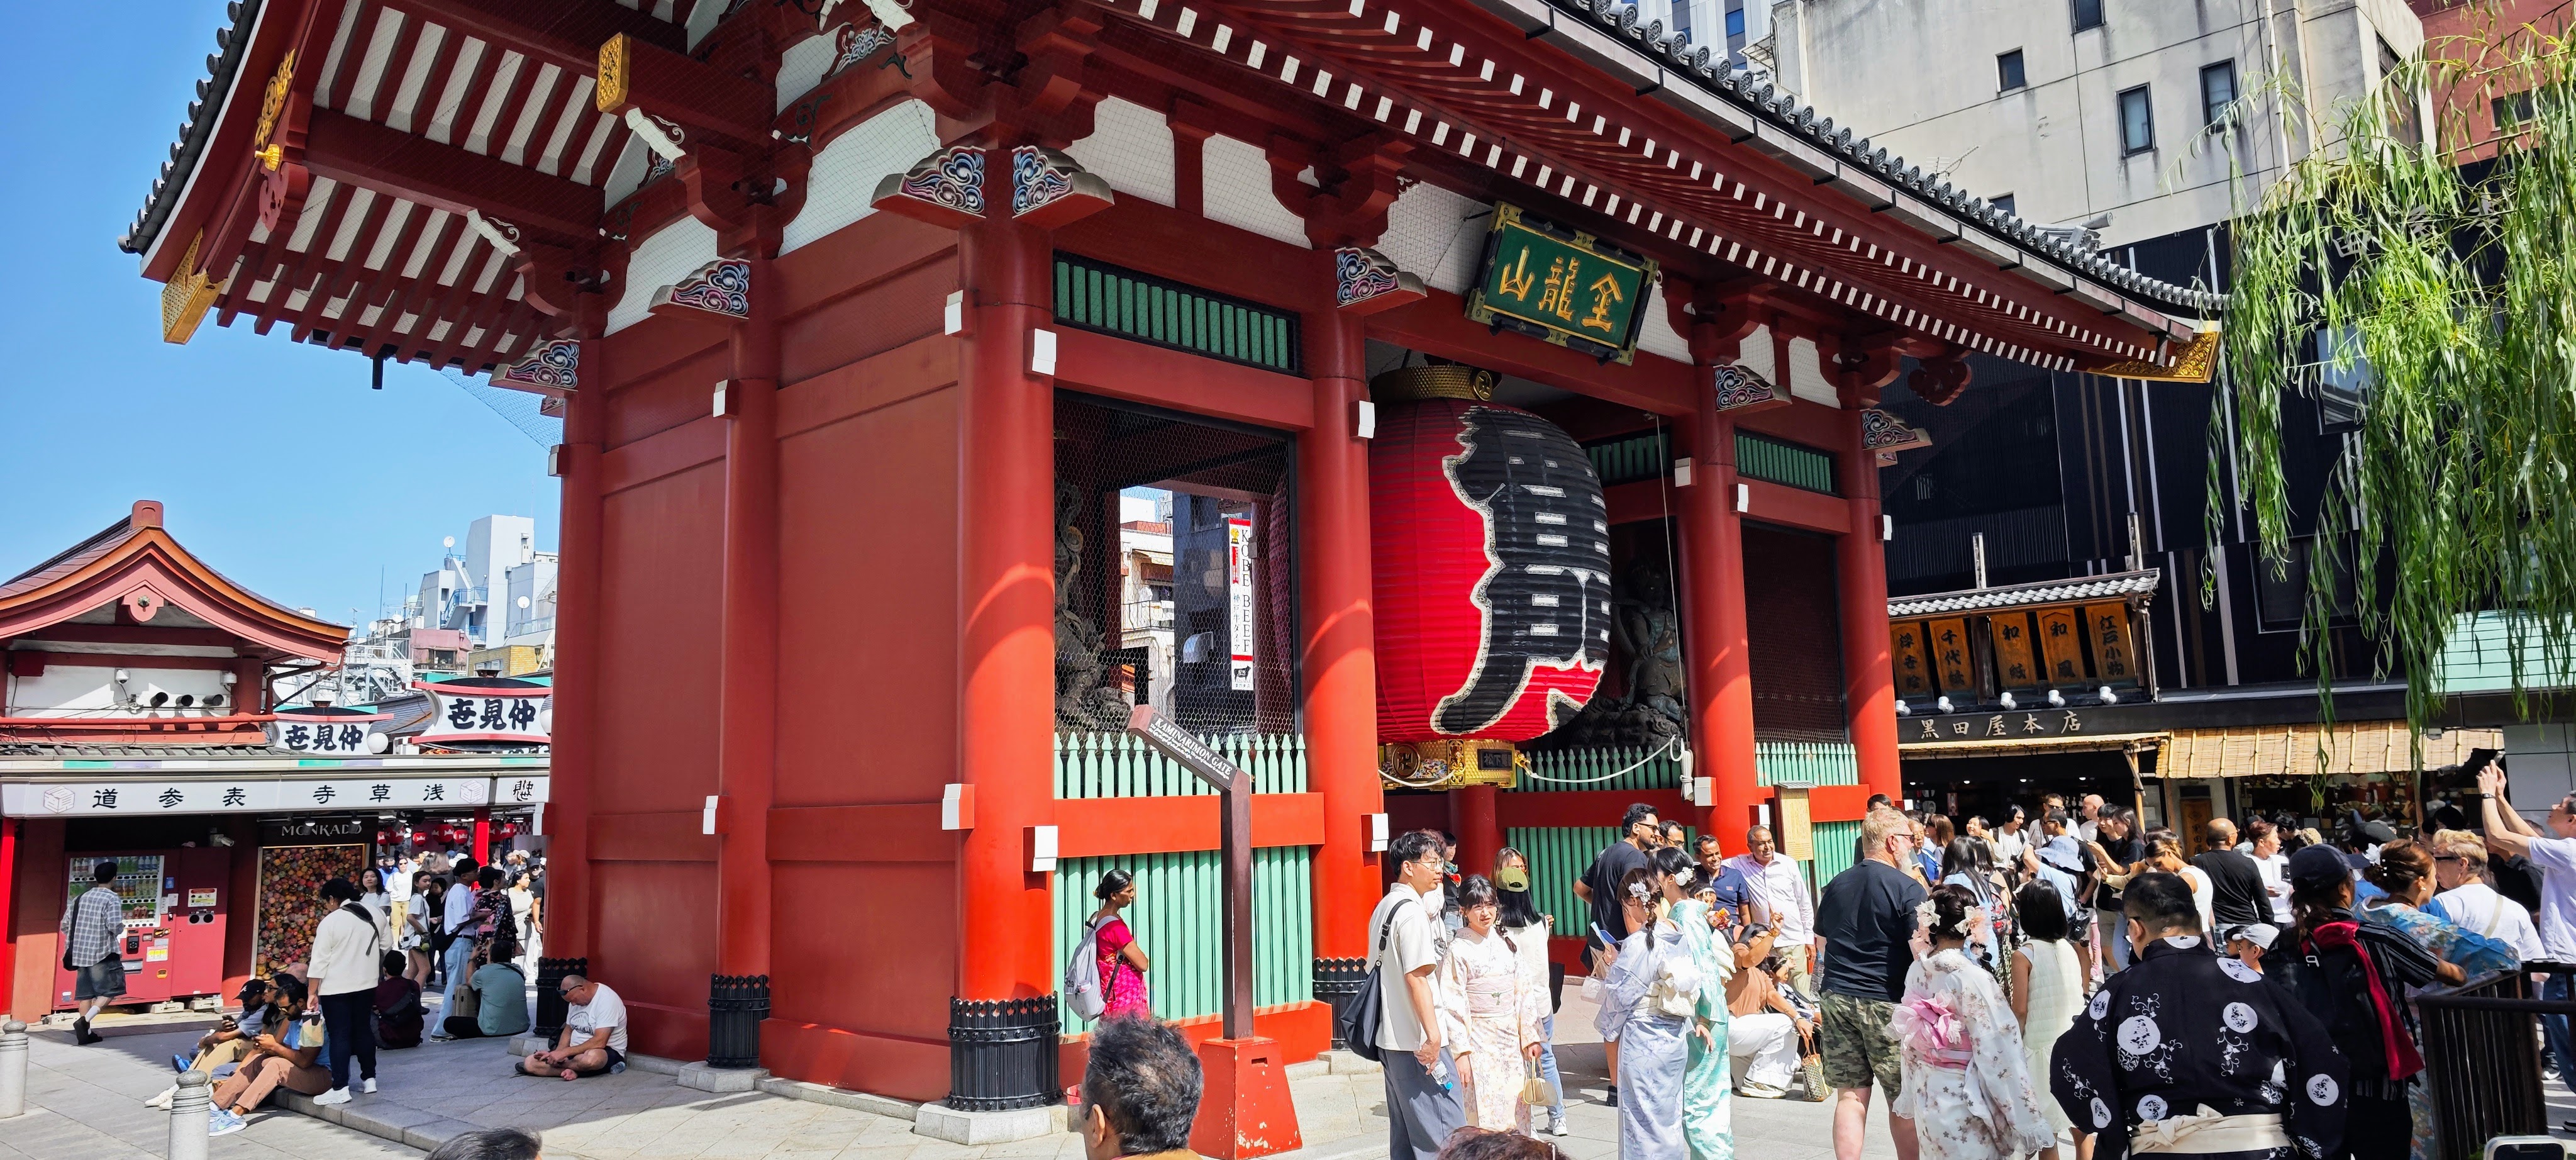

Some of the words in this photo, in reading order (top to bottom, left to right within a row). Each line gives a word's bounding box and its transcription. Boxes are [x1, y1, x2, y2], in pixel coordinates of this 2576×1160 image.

[1241, 529, 1251, 587] KOBE
[1242, 594, 1251, 652] BEEF
[2100, 615, 2124, 676] 江戸小物
[1155, 717, 1212, 762] KAMINARIMON
[1211, 757, 1233, 776] GATE
[1921, 710, 2081, 739] 黒田屋本店
